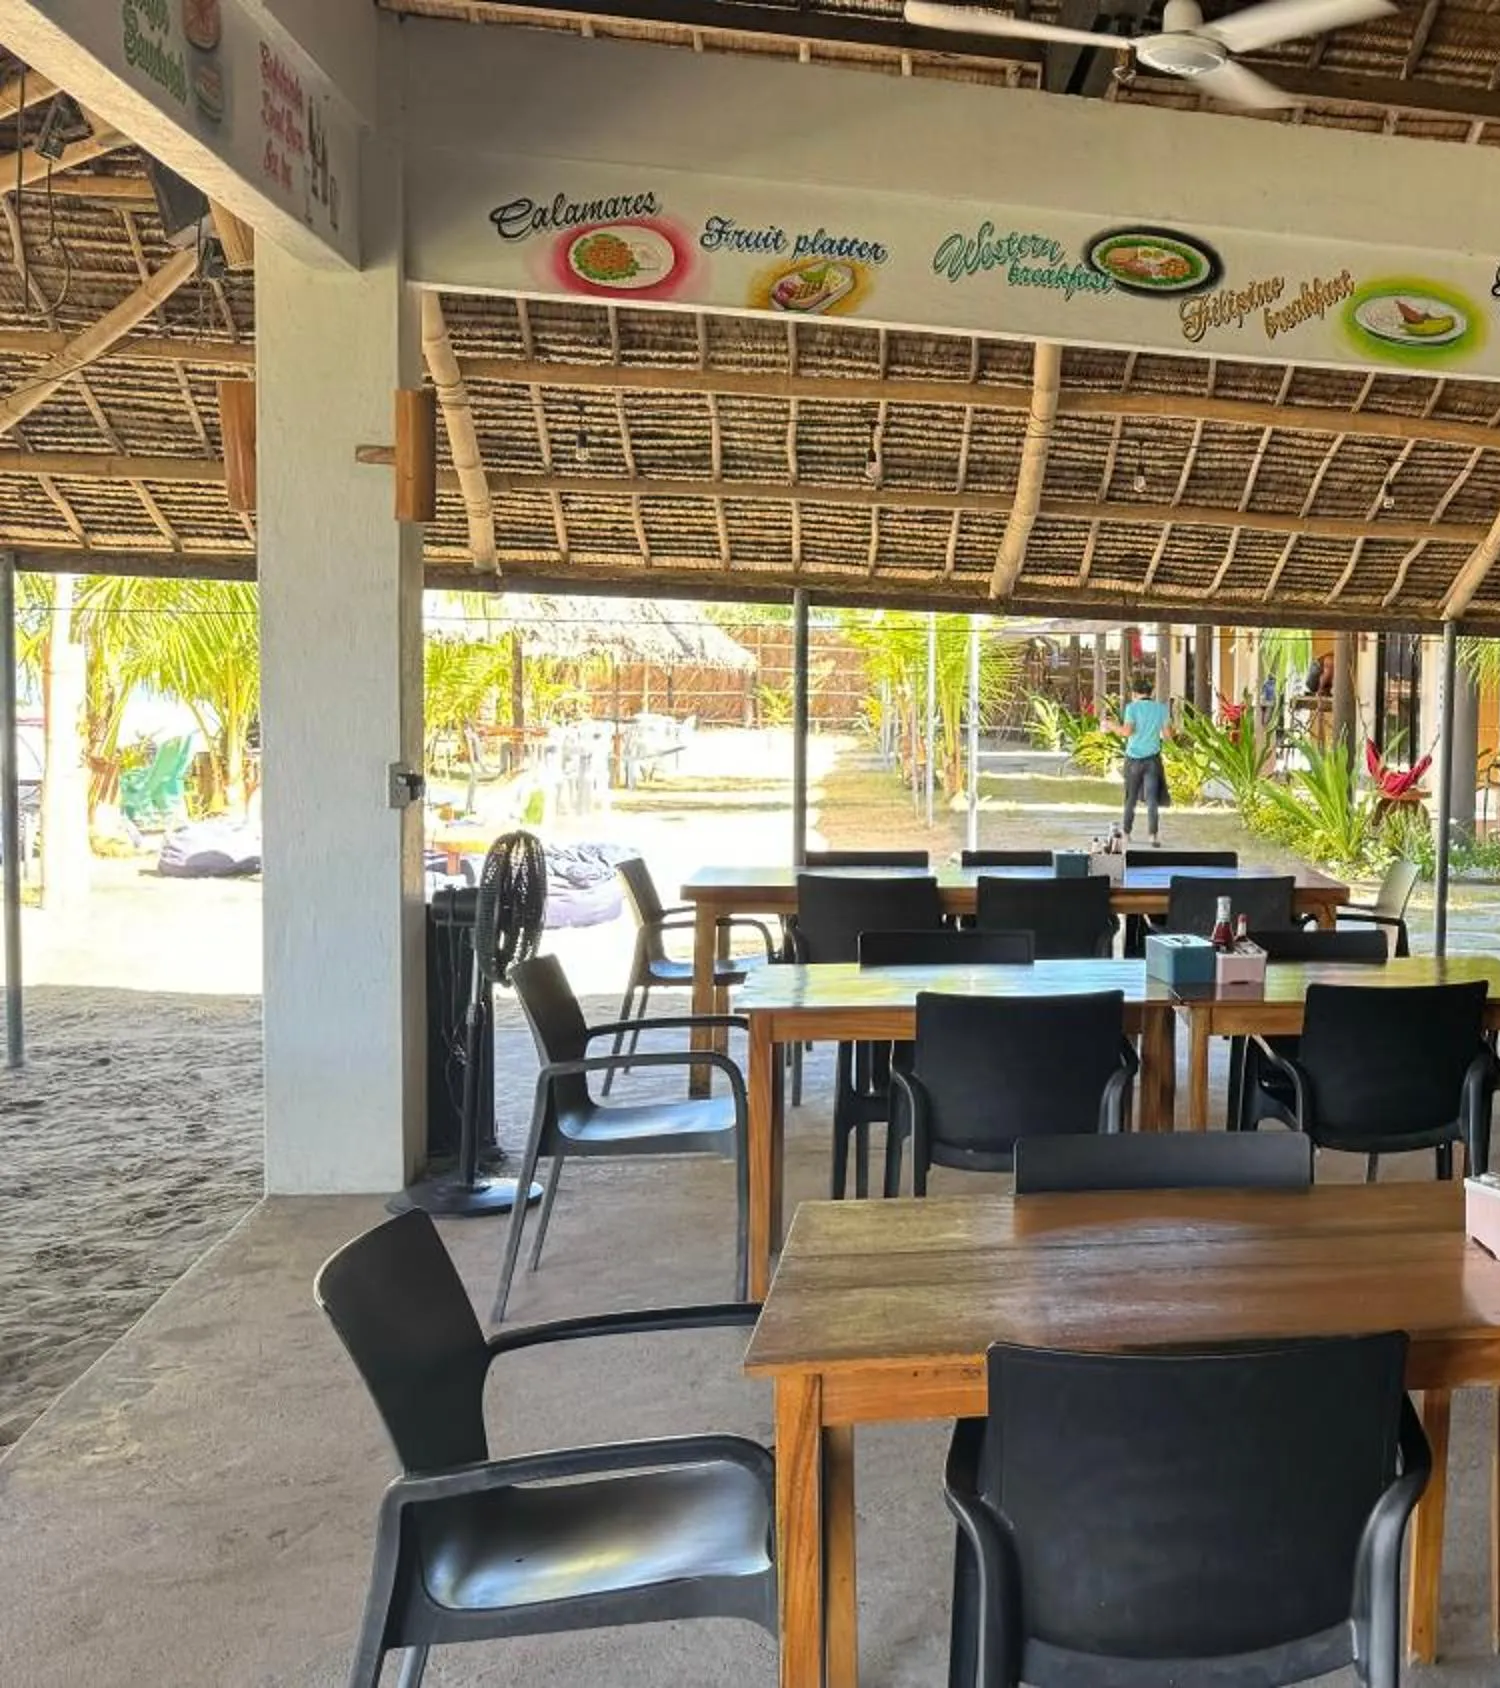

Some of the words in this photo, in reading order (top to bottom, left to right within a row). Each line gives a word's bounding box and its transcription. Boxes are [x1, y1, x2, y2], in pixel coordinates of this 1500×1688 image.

[489, 190, 661, 239] Calamares
[699, 216, 787, 254] Fruit
[793, 229, 888, 262] platter
[932, 220, 1066, 281] Western
